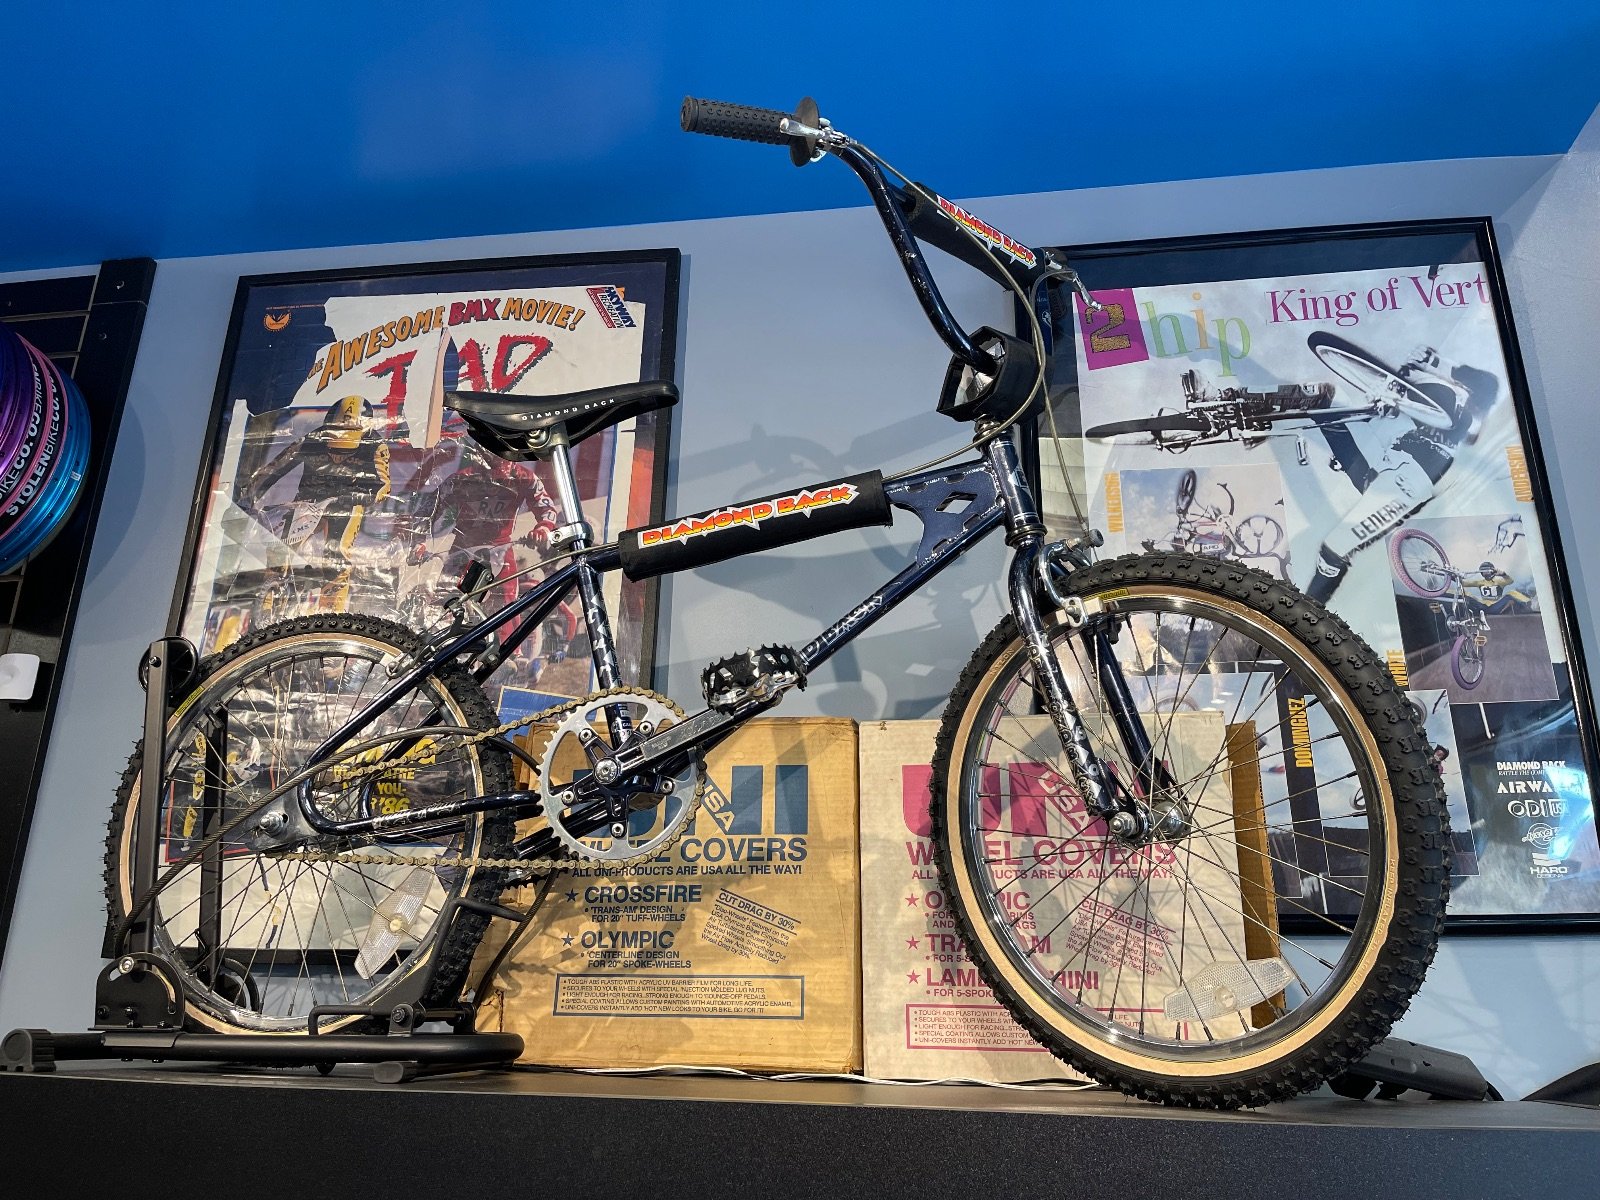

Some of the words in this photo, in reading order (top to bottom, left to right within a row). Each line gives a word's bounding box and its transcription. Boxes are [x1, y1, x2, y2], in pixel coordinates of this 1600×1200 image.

[939, 197, 1002, 245] DIAMOND
[1003, 234, 1035, 264] BACK
[1266, 288, 1359, 326] King
[1367, 278, 1403, 312] of
[1408, 273, 1490, 308] Vert
[1086, 303, 1131, 354] 2
[1142, 292, 1251, 377] hip
[316, 306, 446, 394] AWESOME
[448, 298, 501, 326] BMX
[502, 297, 586, 331] MOVIE!
[522, 406, 578, 421] DIAMOND
[584, 398, 615, 410] BACK
[642, 504, 772, 546] DIAMOND
[777, 486, 853, 515] BACK
[1287, 697, 1314, 768] DOMINGUEZ
[1496, 761, 1541, 770] DIAMOND
[1497, 781, 1553, 794] AIRWA
[1039, 772, 1092, 834] USA
[1507, 799, 1548, 817] ODI
[680, 838, 808, 862] COVERS
[572, 867, 592, 877] ALL
[594, 866, 673, 877] UNI-PRODUCTS
[676, 865, 698, 876] ARE
[700, 865, 724, 875] USA
[725, 865, 747, 875] ALL
[749, 864, 771, 875] THE
[772, 864, 802, 875] WAY!
[911, 870, 934, 879] ALL
[1031, 869, 1056, 879] ARE
[1058, 869, 1082, 879] USA
[1086, 869, 1107, 879] ALL
[1115, 869, 1138, 879] THE
[1530, 866, 1568, 875] HARO
[584, 885, 702, 903] CROSSFIRE
[592, 914, 609, 922] FOR
[627, 913, 686, 922] TUFF-WHEELS
[640, 905, 673, 914] DESIGN
[718, 892, 738, 906] CUT
[737, 900, 764, 917] DRAG
[764, 911, 778, 923] BY
[778, 917, 796, 931] 30%
[932, 911, 953, 919] FOR
[932, 921, 956, 929] AND
[1014, 921, 1036, 930] AGS
[1103, 908, 1133, 926] DRAG
[1135, 920, 1149, 932] BY
[581, 930, 675, 949] OLYMPIC
[646, 950, 680, 959] DESIGN
[933, 954, 954, 962] FOR
[588, 960, 605, 968] FOR
[623, 960, 692, 968] SPOKE-WHEELS
[933, 989, 954, 997] FOR
